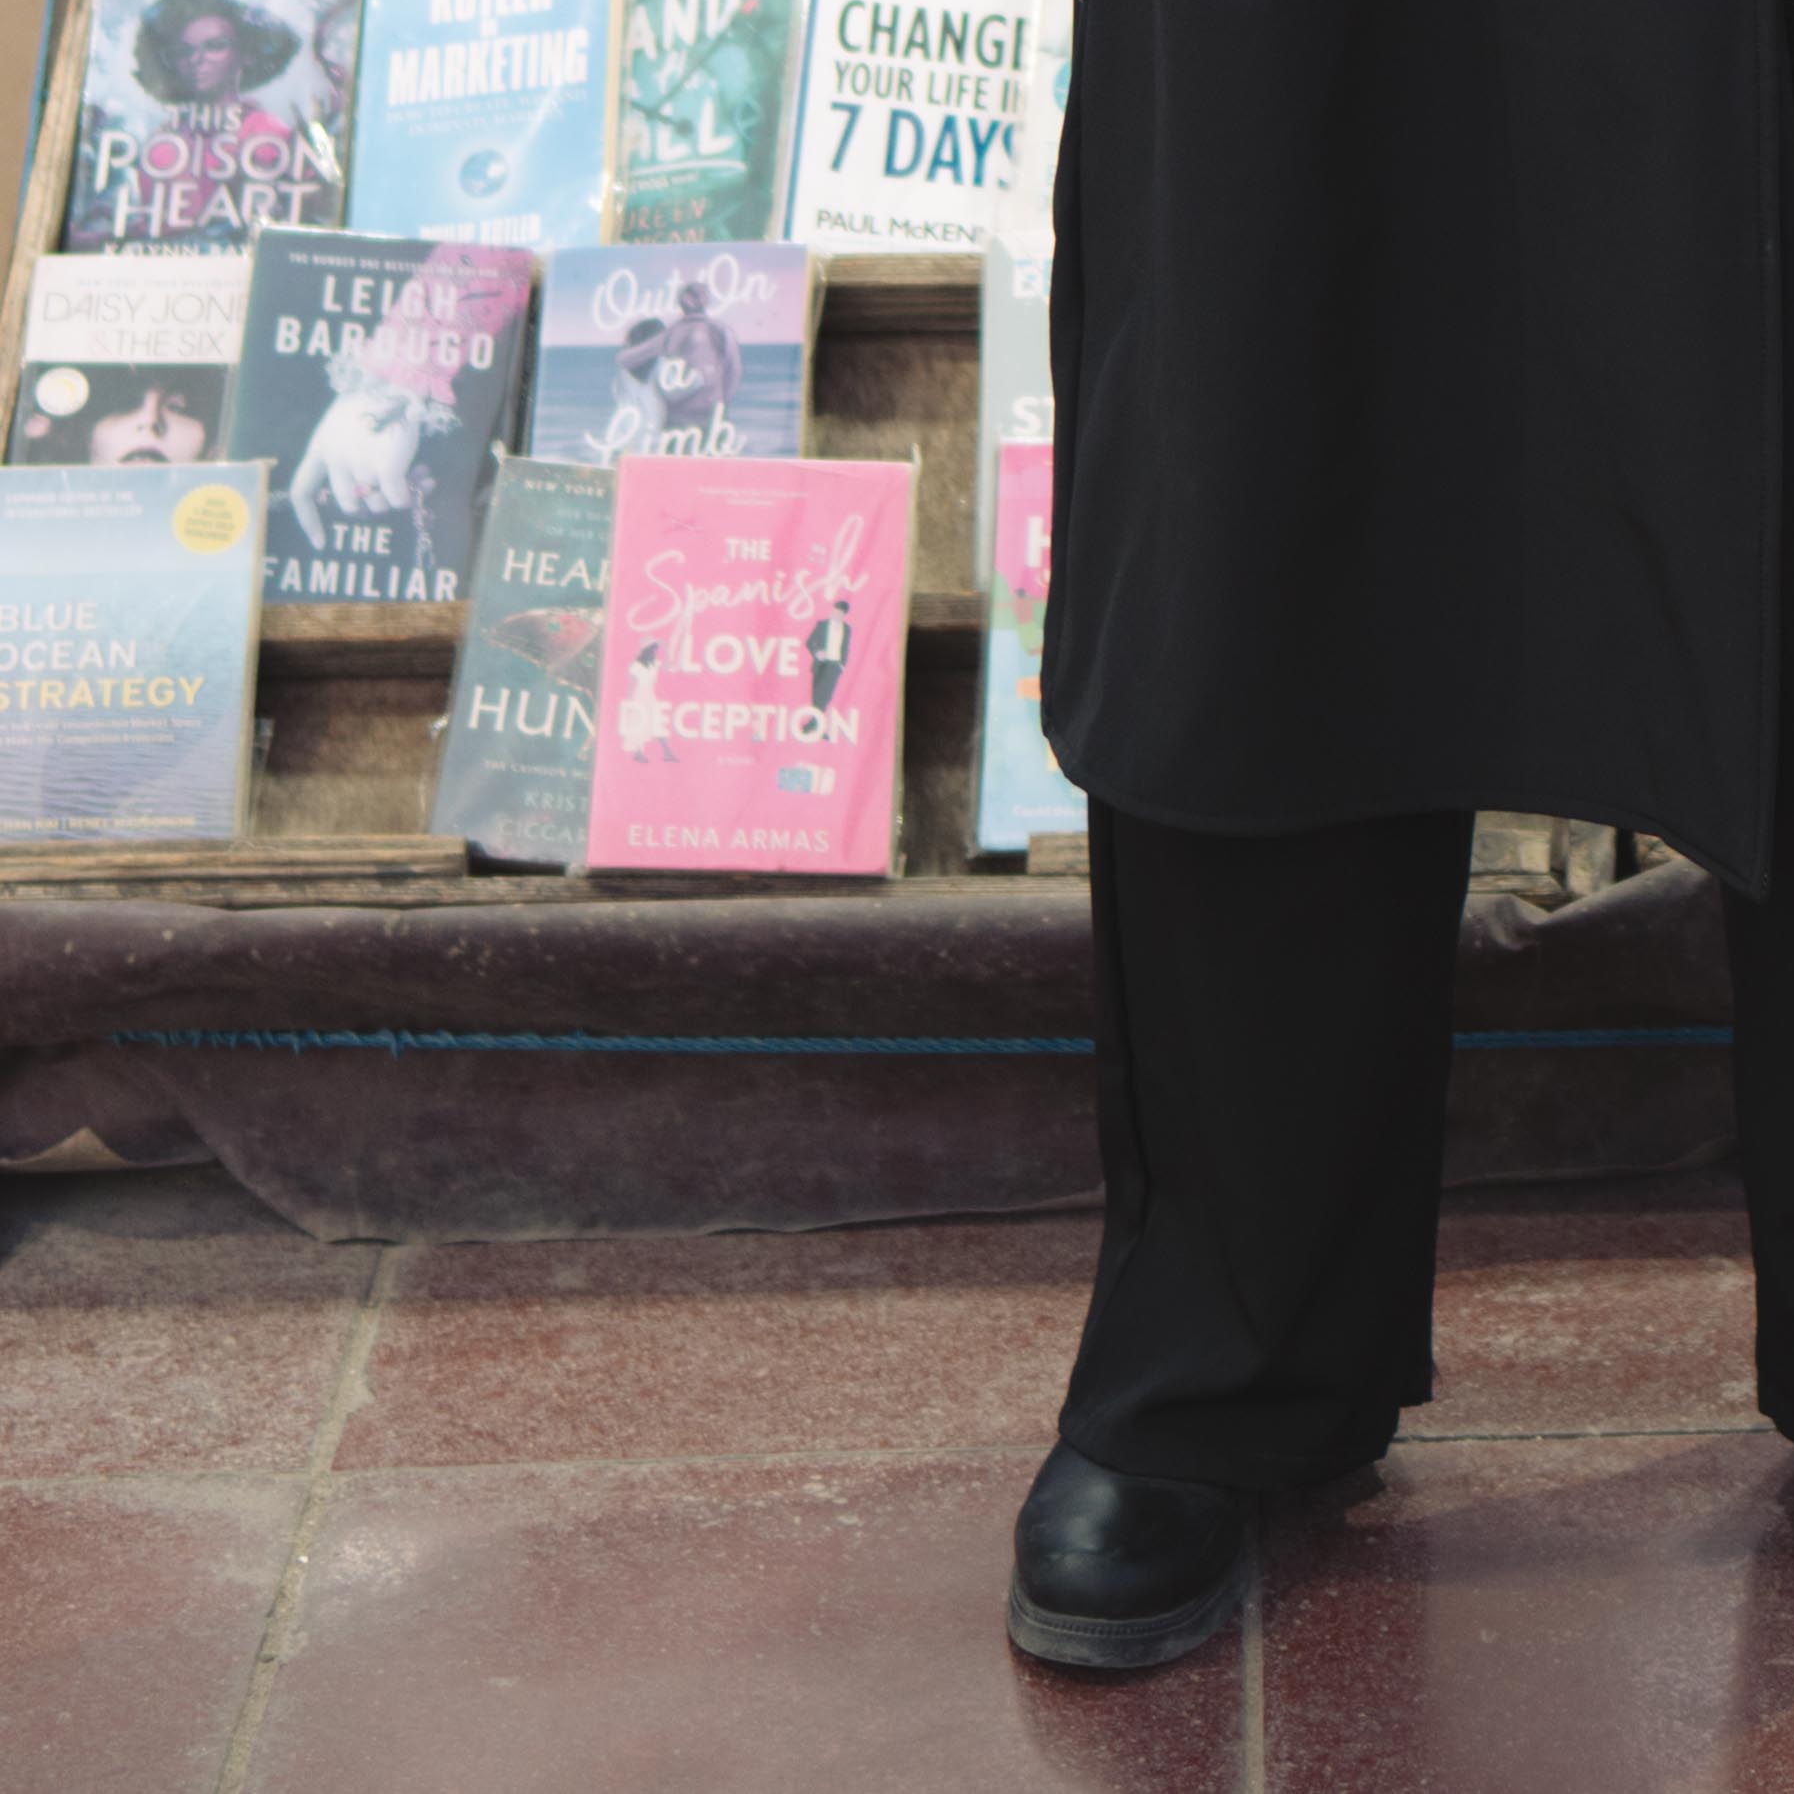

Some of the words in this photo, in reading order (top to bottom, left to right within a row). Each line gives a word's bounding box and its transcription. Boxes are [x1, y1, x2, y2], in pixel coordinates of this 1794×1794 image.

[387, 27, 590, 107] MARKETING
[832, 59, 913, 103] YOUR
[926, 71, 989, 111] LIFE
[168, 103, 243, 132] THIS
[828, 101, 864, 172] 7
[94, 130, 337, 192] POISON
[112, 182, 321, 239] HEART
[815, 209, 882, 233] PAUL
[889, 217, 981, 244] McKEN
[42, 291, 148, 324] DAISY
[321, 273, 460, 322] LEIGH
[592, 267, 681, 332] Out
[698, 252, 779, 310] On
[115, 329, 177, 357] THE
[178, 329, 227, 357] SIX
[274, 317, 496, 371] BARDUGO
[658, 356, 700, 391] a
[584, 402, 747, 458] Limb
[330, 521, 393, 556] THE
[724, 536, 773, 563] THE
[262, 555, 459, 603] FAMILIAR
[625, 514, 872, 672] Spanish
[0, 600, 98, 633] BLUE
[0, 639, 138, 672] OCEAN
[678, 633, 801, 678] LOVE
[0, 675, 205, 710] STRATEGY
[467, 684, 596, 740] HUN
[617, 699, 861, 747] DECEPTION
[523, 791, 588, 813] KRIST
[625, 823, 721, 850] ELENA
[728, 827, 831, 854] ARMAS
